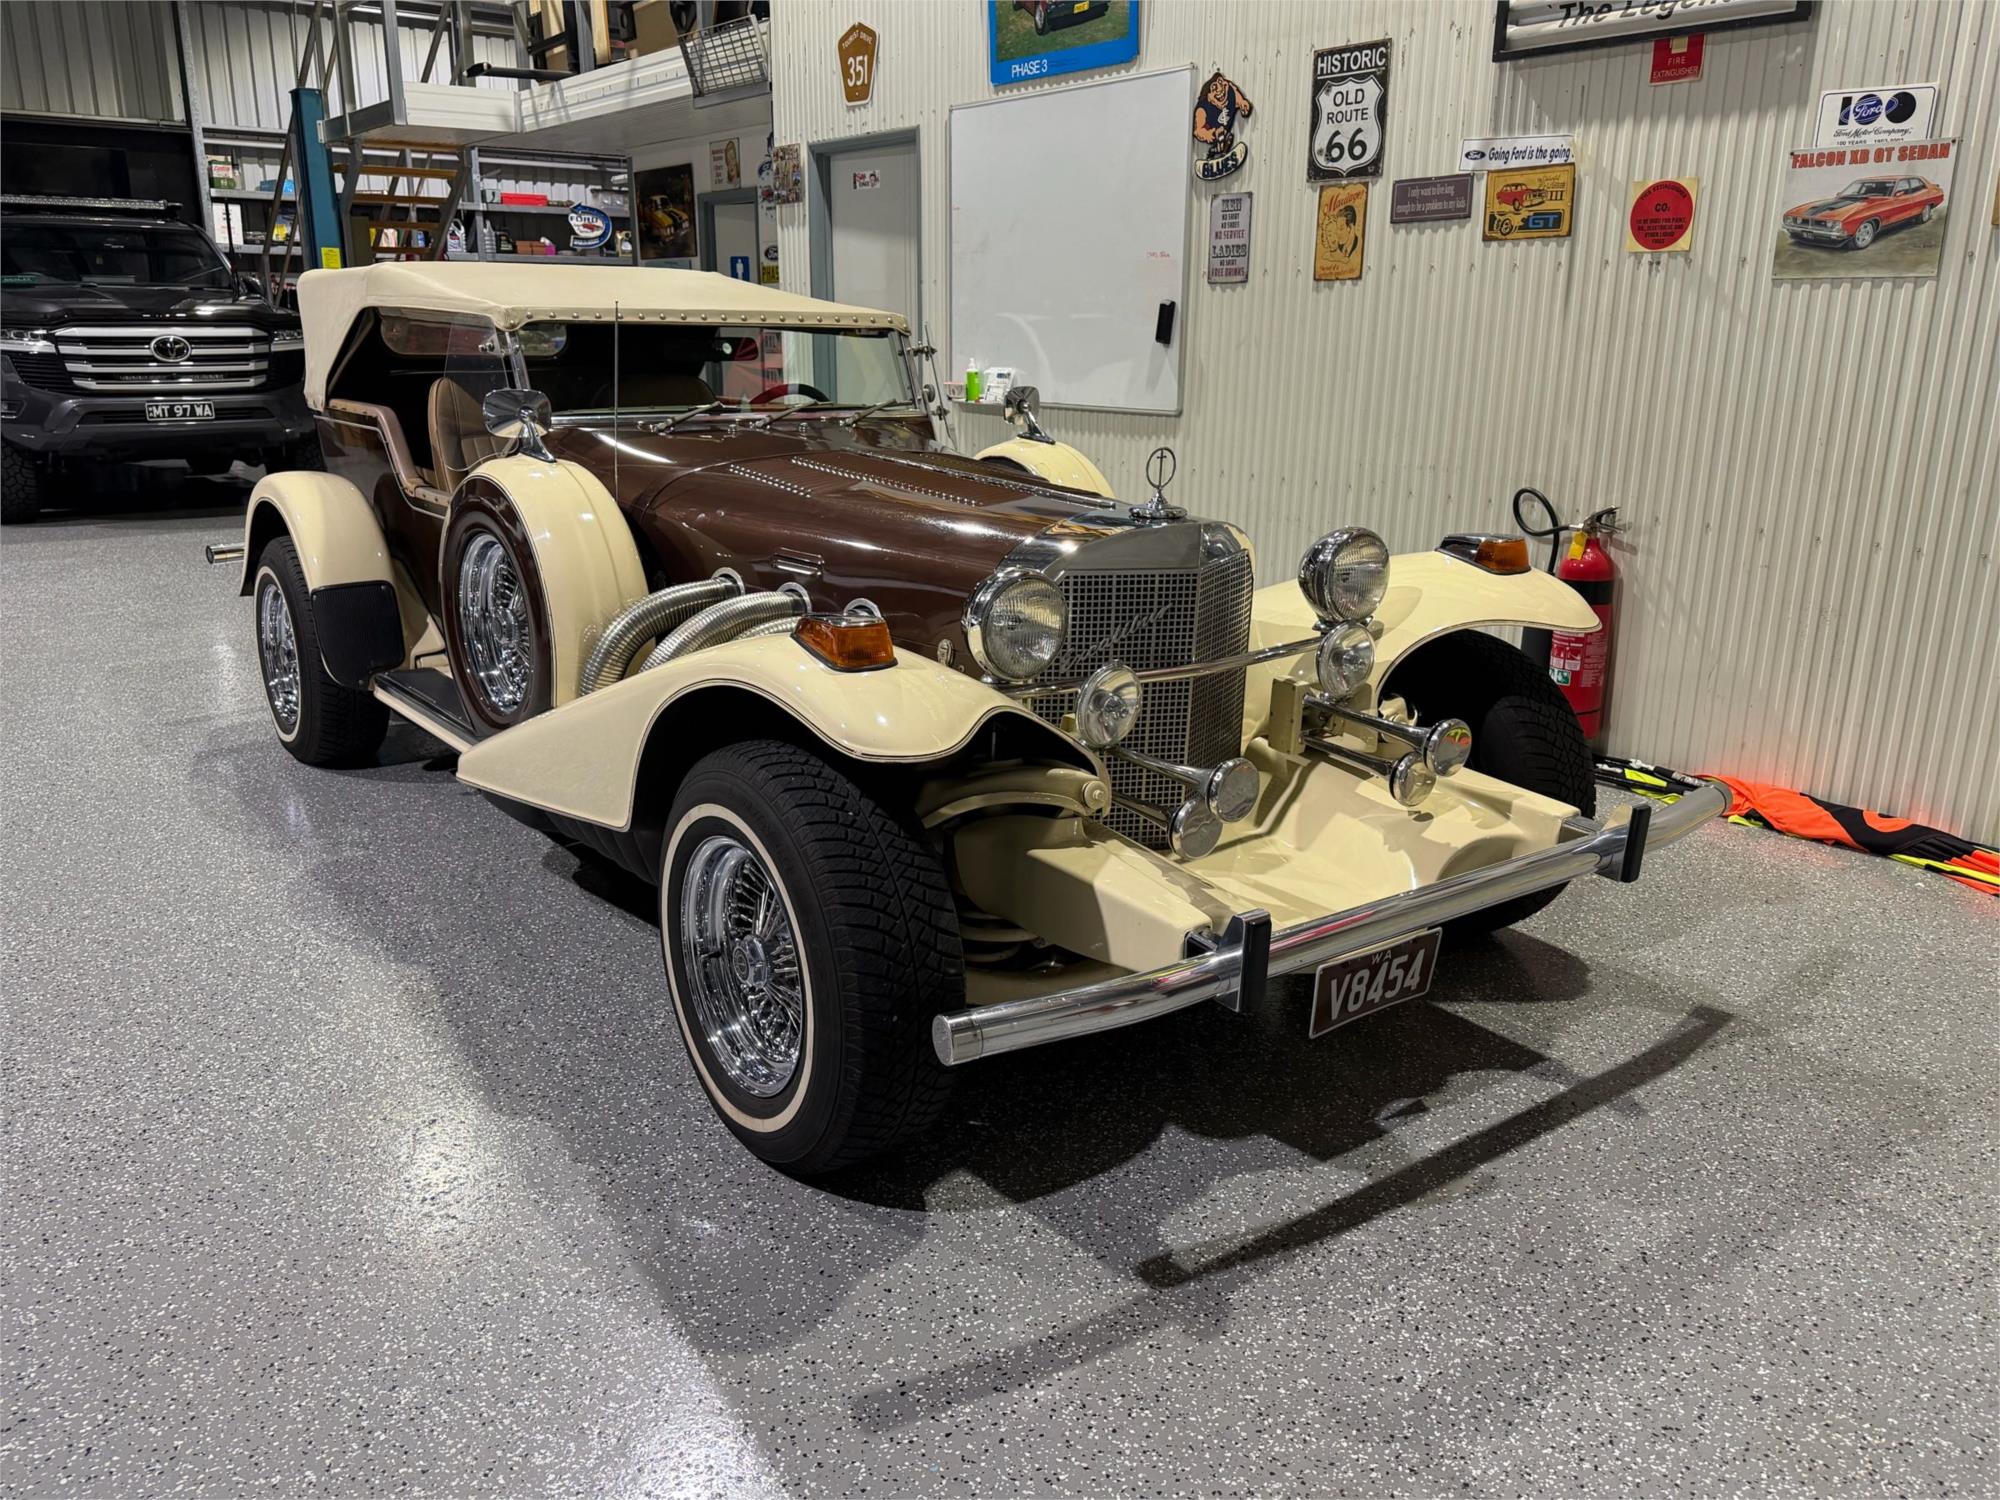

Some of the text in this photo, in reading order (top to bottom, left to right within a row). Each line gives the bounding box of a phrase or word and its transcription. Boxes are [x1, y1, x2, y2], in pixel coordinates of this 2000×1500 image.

[1011, 59, 1048, 78] PHASE 3
[1317, 46, 1386, 75] HISTORIC
[1667, 56, 1686, 66] FIRE
[847, 54, 868, 87] 351
[1652, 65, 1699, 79] EXTINGUISHER
[1333, 88, 1365, 107] OLD
[1326, 107, 1369, 125] ROUTE
[1325, 127, 1368, 163] 66
[1489, 147, 1509, 164] Going
[1510, 146, 1528, 160] Ford
[1528, 146, 1535, 159] is
[1535, 145, 1548, 159] the
[1791, 151, 1847, 169] FALCON
[1873, 147, 1895, 162] GT
[1897, 143, 1951, 161] SEDAN
[1202, 152, 1238, 179] BLUES
[1528, 213, 1560, 228] GT
[1215, 229, 1246, 240] NO SERVICE
[1212, 244, 1247, 258] LADIES
[1211, 267, 1245, 277] FREE DRINKS
[153, 404, 212, 418] MT 97 WA
[1371, 950, 1392, 965] WA
[1330, 948, 1416, 1021] V8454
